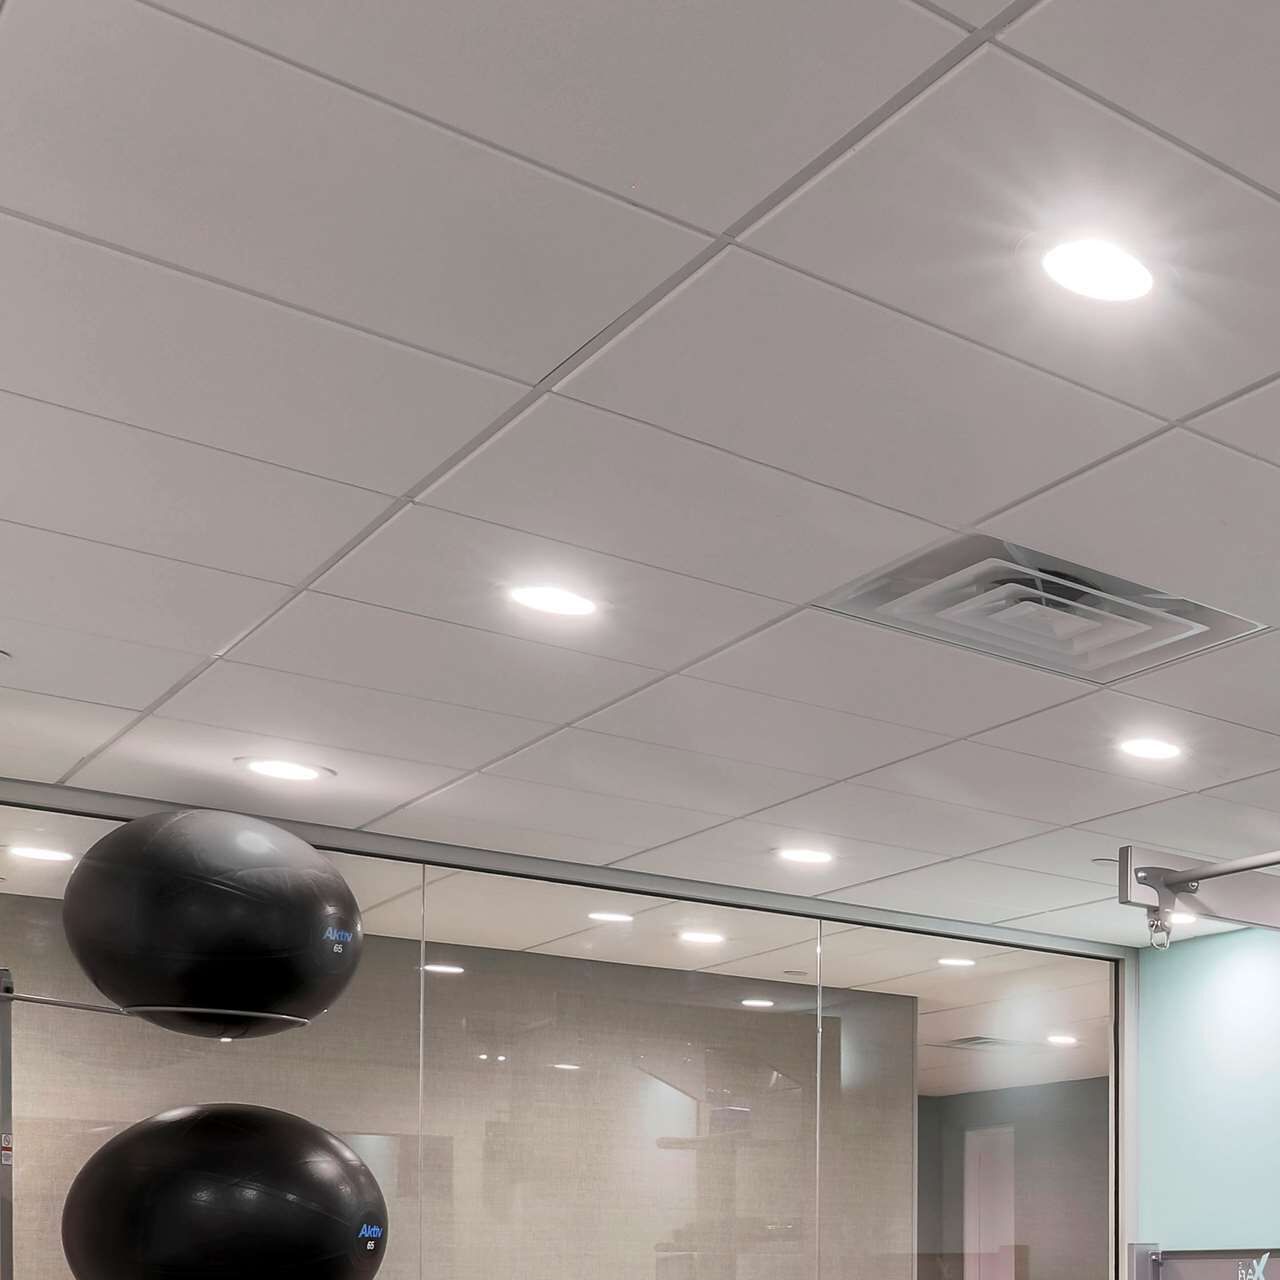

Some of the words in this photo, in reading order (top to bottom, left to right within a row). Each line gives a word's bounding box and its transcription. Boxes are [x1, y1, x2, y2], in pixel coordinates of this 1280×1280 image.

[322, 926, 353, 942] Aktiv
[333, 943, 343, 953] 65
[358, 1223, 384, 1238] Aktiv
